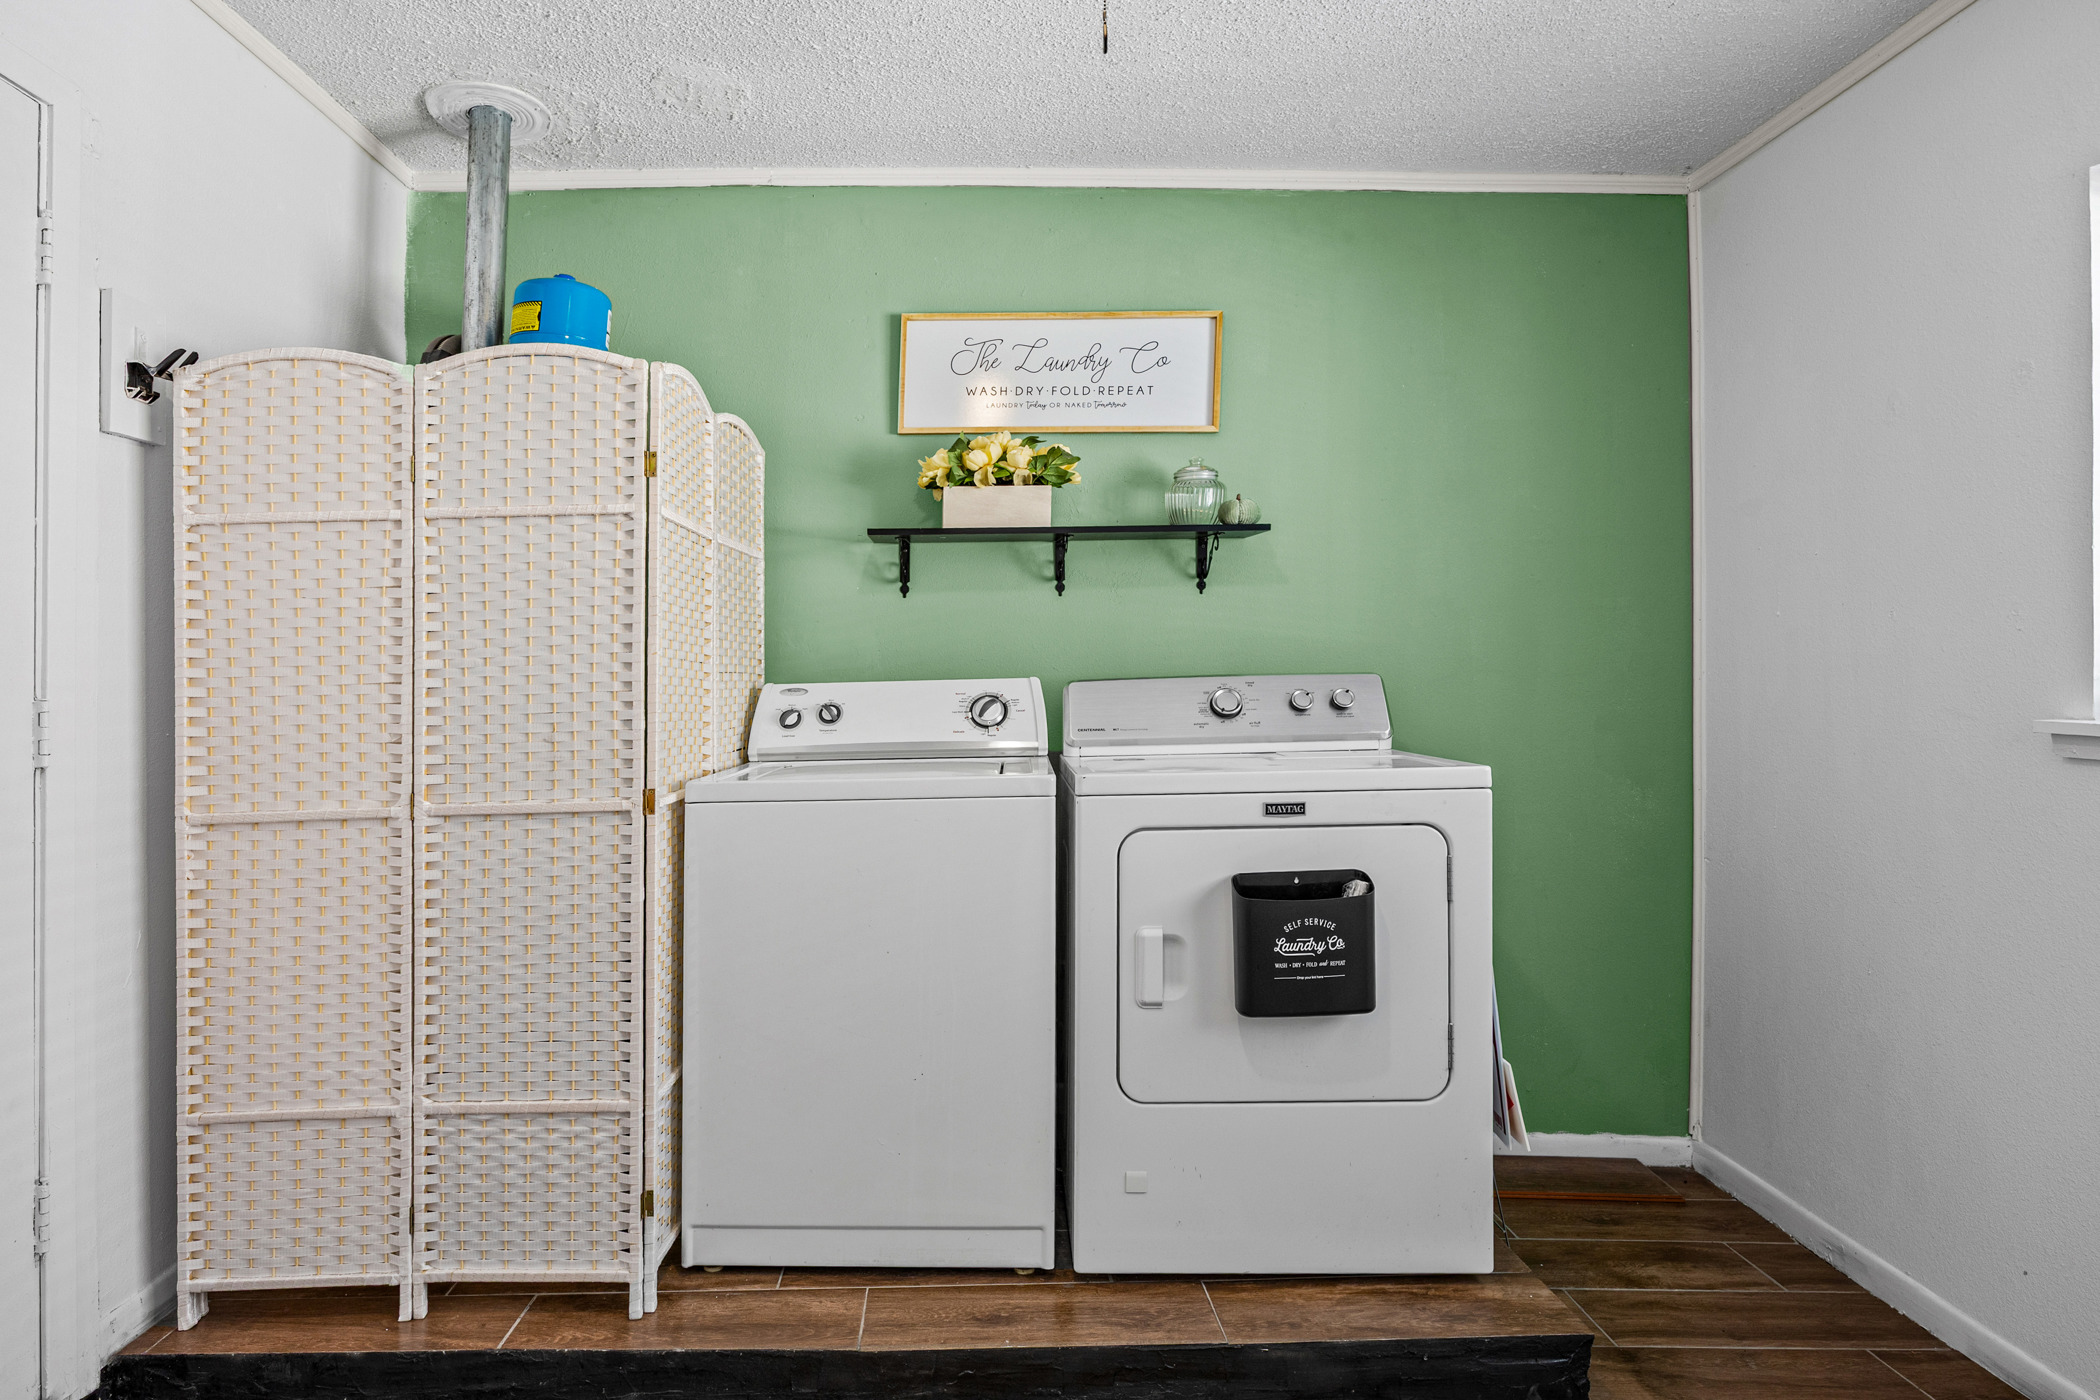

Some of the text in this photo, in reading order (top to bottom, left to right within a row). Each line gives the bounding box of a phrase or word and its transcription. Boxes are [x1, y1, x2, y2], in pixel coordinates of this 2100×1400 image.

[950, 337, 1171, 384] The Laundry Co
[965, 385, 1154, 396] WASH DRY FOLD REPEAT
[1267, 805, 1304, 814] MAYTAG
[1284, 918, 1336, 932] SELF SERVICE
[1273, 937, 1327, 957] Laundry
